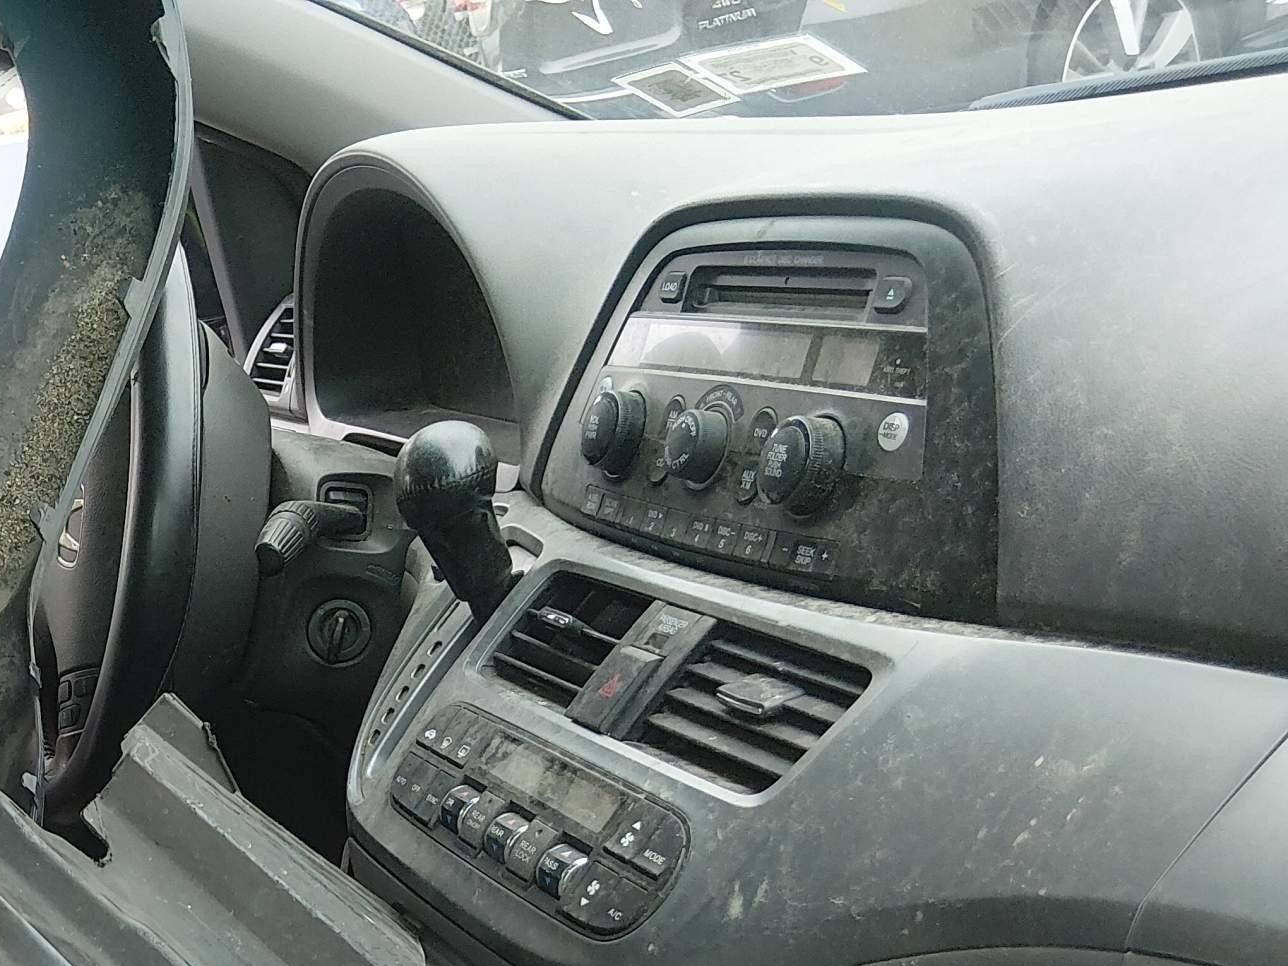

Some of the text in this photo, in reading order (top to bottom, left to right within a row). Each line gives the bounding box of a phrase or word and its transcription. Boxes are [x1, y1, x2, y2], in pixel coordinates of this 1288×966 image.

[697, 7, 757, 32] PLATINUM
[662, 280, 678, 292] LOAD
[753, 427, 768, 439] DVD
[772, 443, 789, 453] TUNE
[766, 452, 788, 463] FOLDER
[742, 469, 757, 480] AUX
[740, 481, 753, 490] XM
[797, 545, 815, 557] SEEK
[794, 554, 812, 565] SKIP
[520, 839, 537, 855] REAR
[515, 851, 530, 864] LOCK
[643, 848, 666, 866] MODE
[543, 856, 560, 871] PASS
[607, 907, 623, 921] A/C
